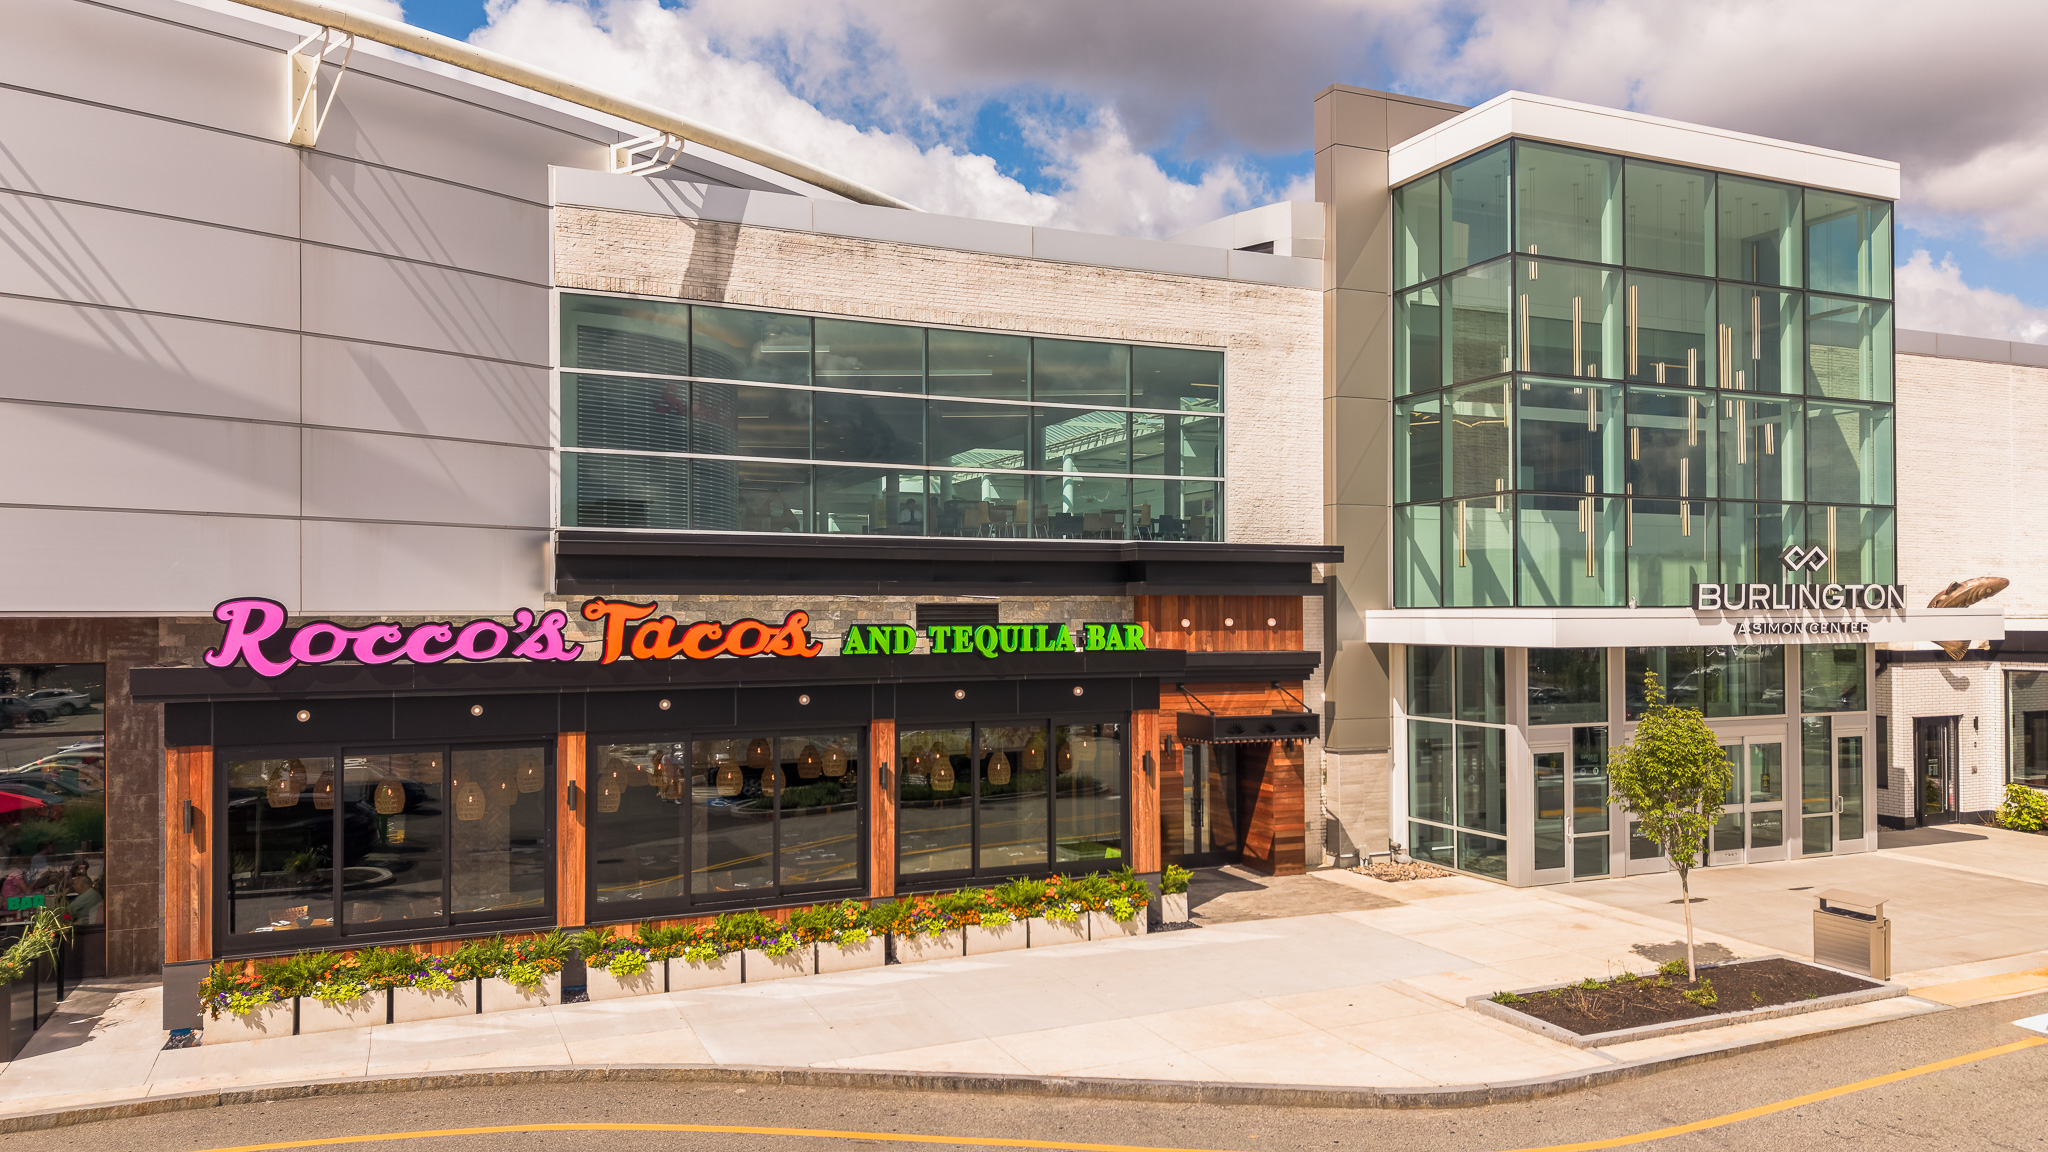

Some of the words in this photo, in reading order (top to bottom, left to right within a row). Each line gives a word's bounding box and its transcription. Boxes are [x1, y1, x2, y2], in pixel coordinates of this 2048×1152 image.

[1693, 583, 1907, 610] BURLINGTON
[203, 597, 584, 677] Rocco's
[582, 597, 823, 665] Tacos
[843, 625, 917, 655] AND
[928, 624, 1076, 659] TEQUILA
[1085, 624, 1147, 651] BAR
[1735, 622, 1747, 635] A
[1751, 622, 1803, 635] SIMON
[1808, 621, 1870, 634] CENTER
[8, 895, 45, 910] BAR
